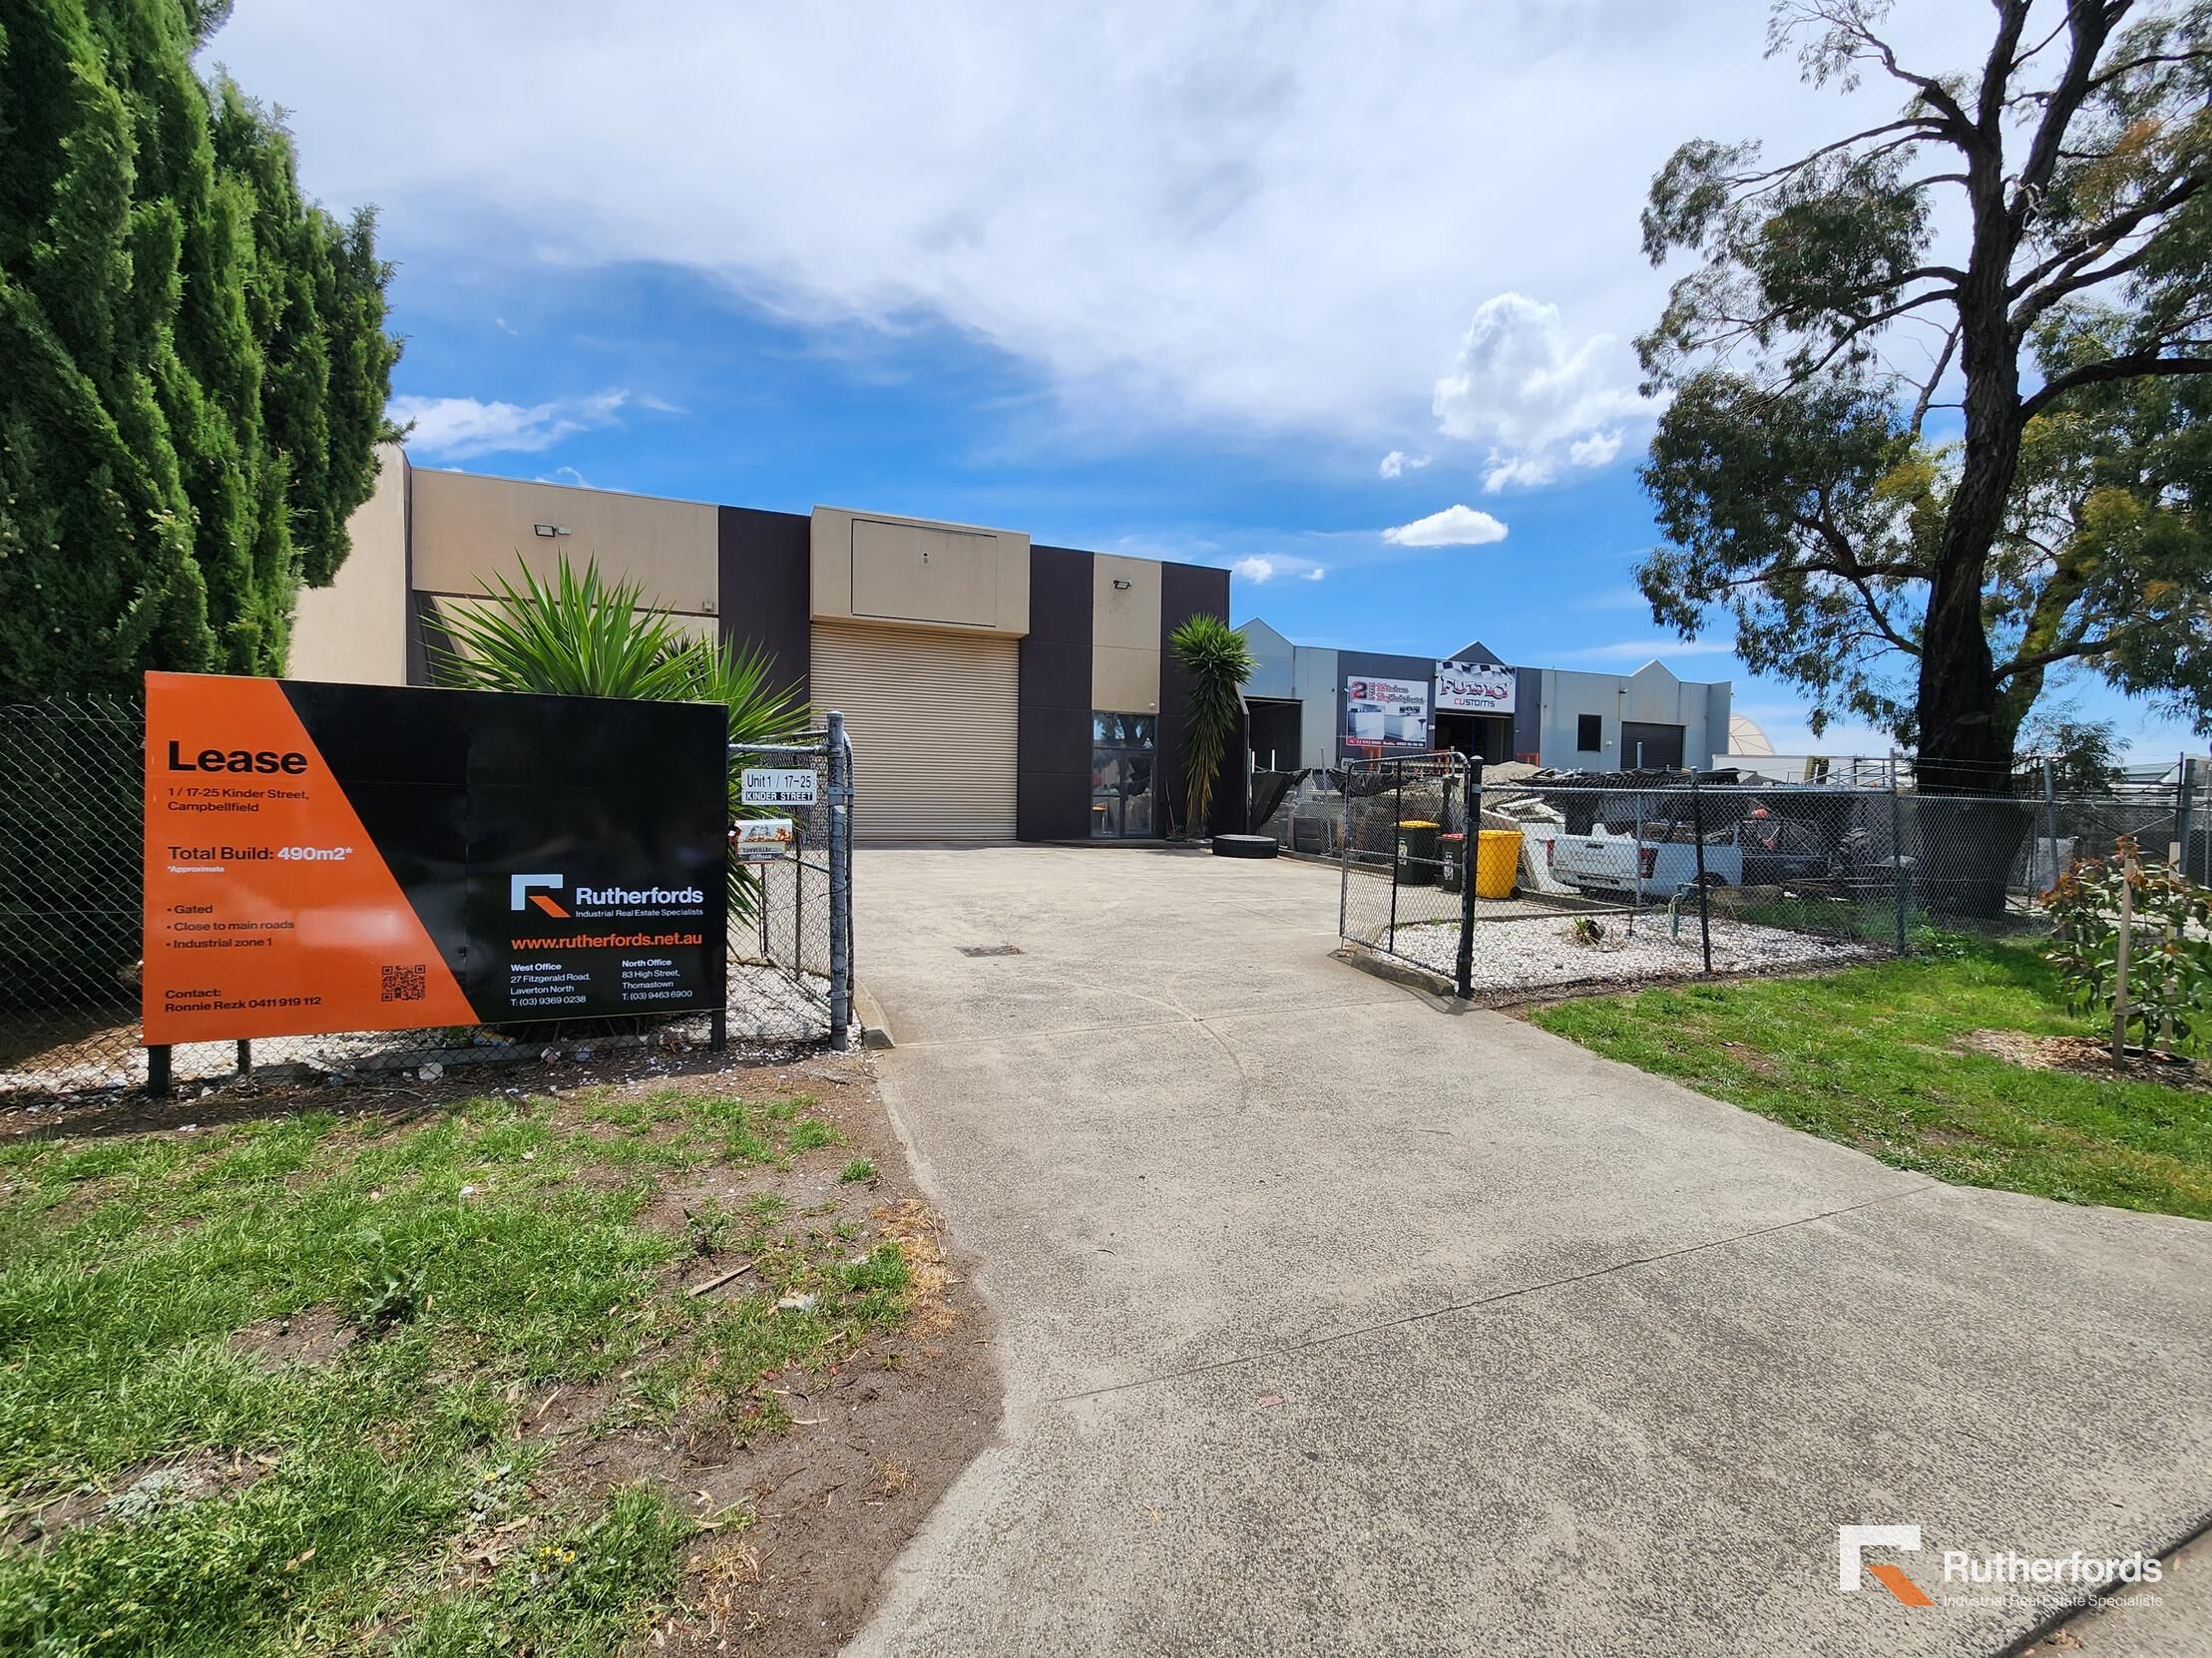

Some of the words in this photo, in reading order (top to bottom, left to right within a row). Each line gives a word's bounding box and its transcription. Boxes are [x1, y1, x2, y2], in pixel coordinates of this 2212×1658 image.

[168, 740, 307, 774] Lease
[784, 775, 811, 788] 17-25
[168, 788, 175, 797] 1
[187, 788, 220, 798] 17-25
[222, 788, 264, 798] Kinder
[267, 789, 309, 799] Street,
[746, 792, 777, 801] KINDER
[780, 792, 812, 801] STREET
[168, 801, 259, 813] Campbellfield
[168, 846, 217, 860] Total
[221, 847, 273, 861] Build:
[576, 887, 703, 905] Rutherfords
[175, 905, 214, 915] Gated
[661, 908, 703, 918] Specialists
[174, 922, 211, 932] Close
[227, 921, 258, 931] main
[260, 920, 294, 930] roads
[174, 938, 232, 949] Industrial
[234, 939, 264, 948] zone
[266, 938, 272, 947] 1
[511, 933, 702, 950] www.rutherfords.net.au
[535, 963, 562, 972] Office
[523, 974, 566, 984] Fitzgerald
[567, 973, 591, 982] Road,
[634, 971, 653, 980] High
[654, 969, 680, 978] Street,
[511, 986, 549, 996] Laverton
[550, 985, 575, 994] North
[622, 981, 673, 990] Thomastown
[166, 989, 221, 999] Contact:
[630, 992, 648, 1001] (03)
[648, 991, 668, 1000] 9463
[669, 990, 692, 999] 6900
[165, 1001, 212, 1013] Ronnie
[214, 1000, 246, 1012] Rezk
[249, 999, 275, 1010] 0411
[277, 998, 300, 1009] 919
[302, 997, 321, 1008] 112
[519, 997, 538, 1007] (03)
[538, 997, 563, 1006] 9369
[563, 996, 587, 1005] 0238
